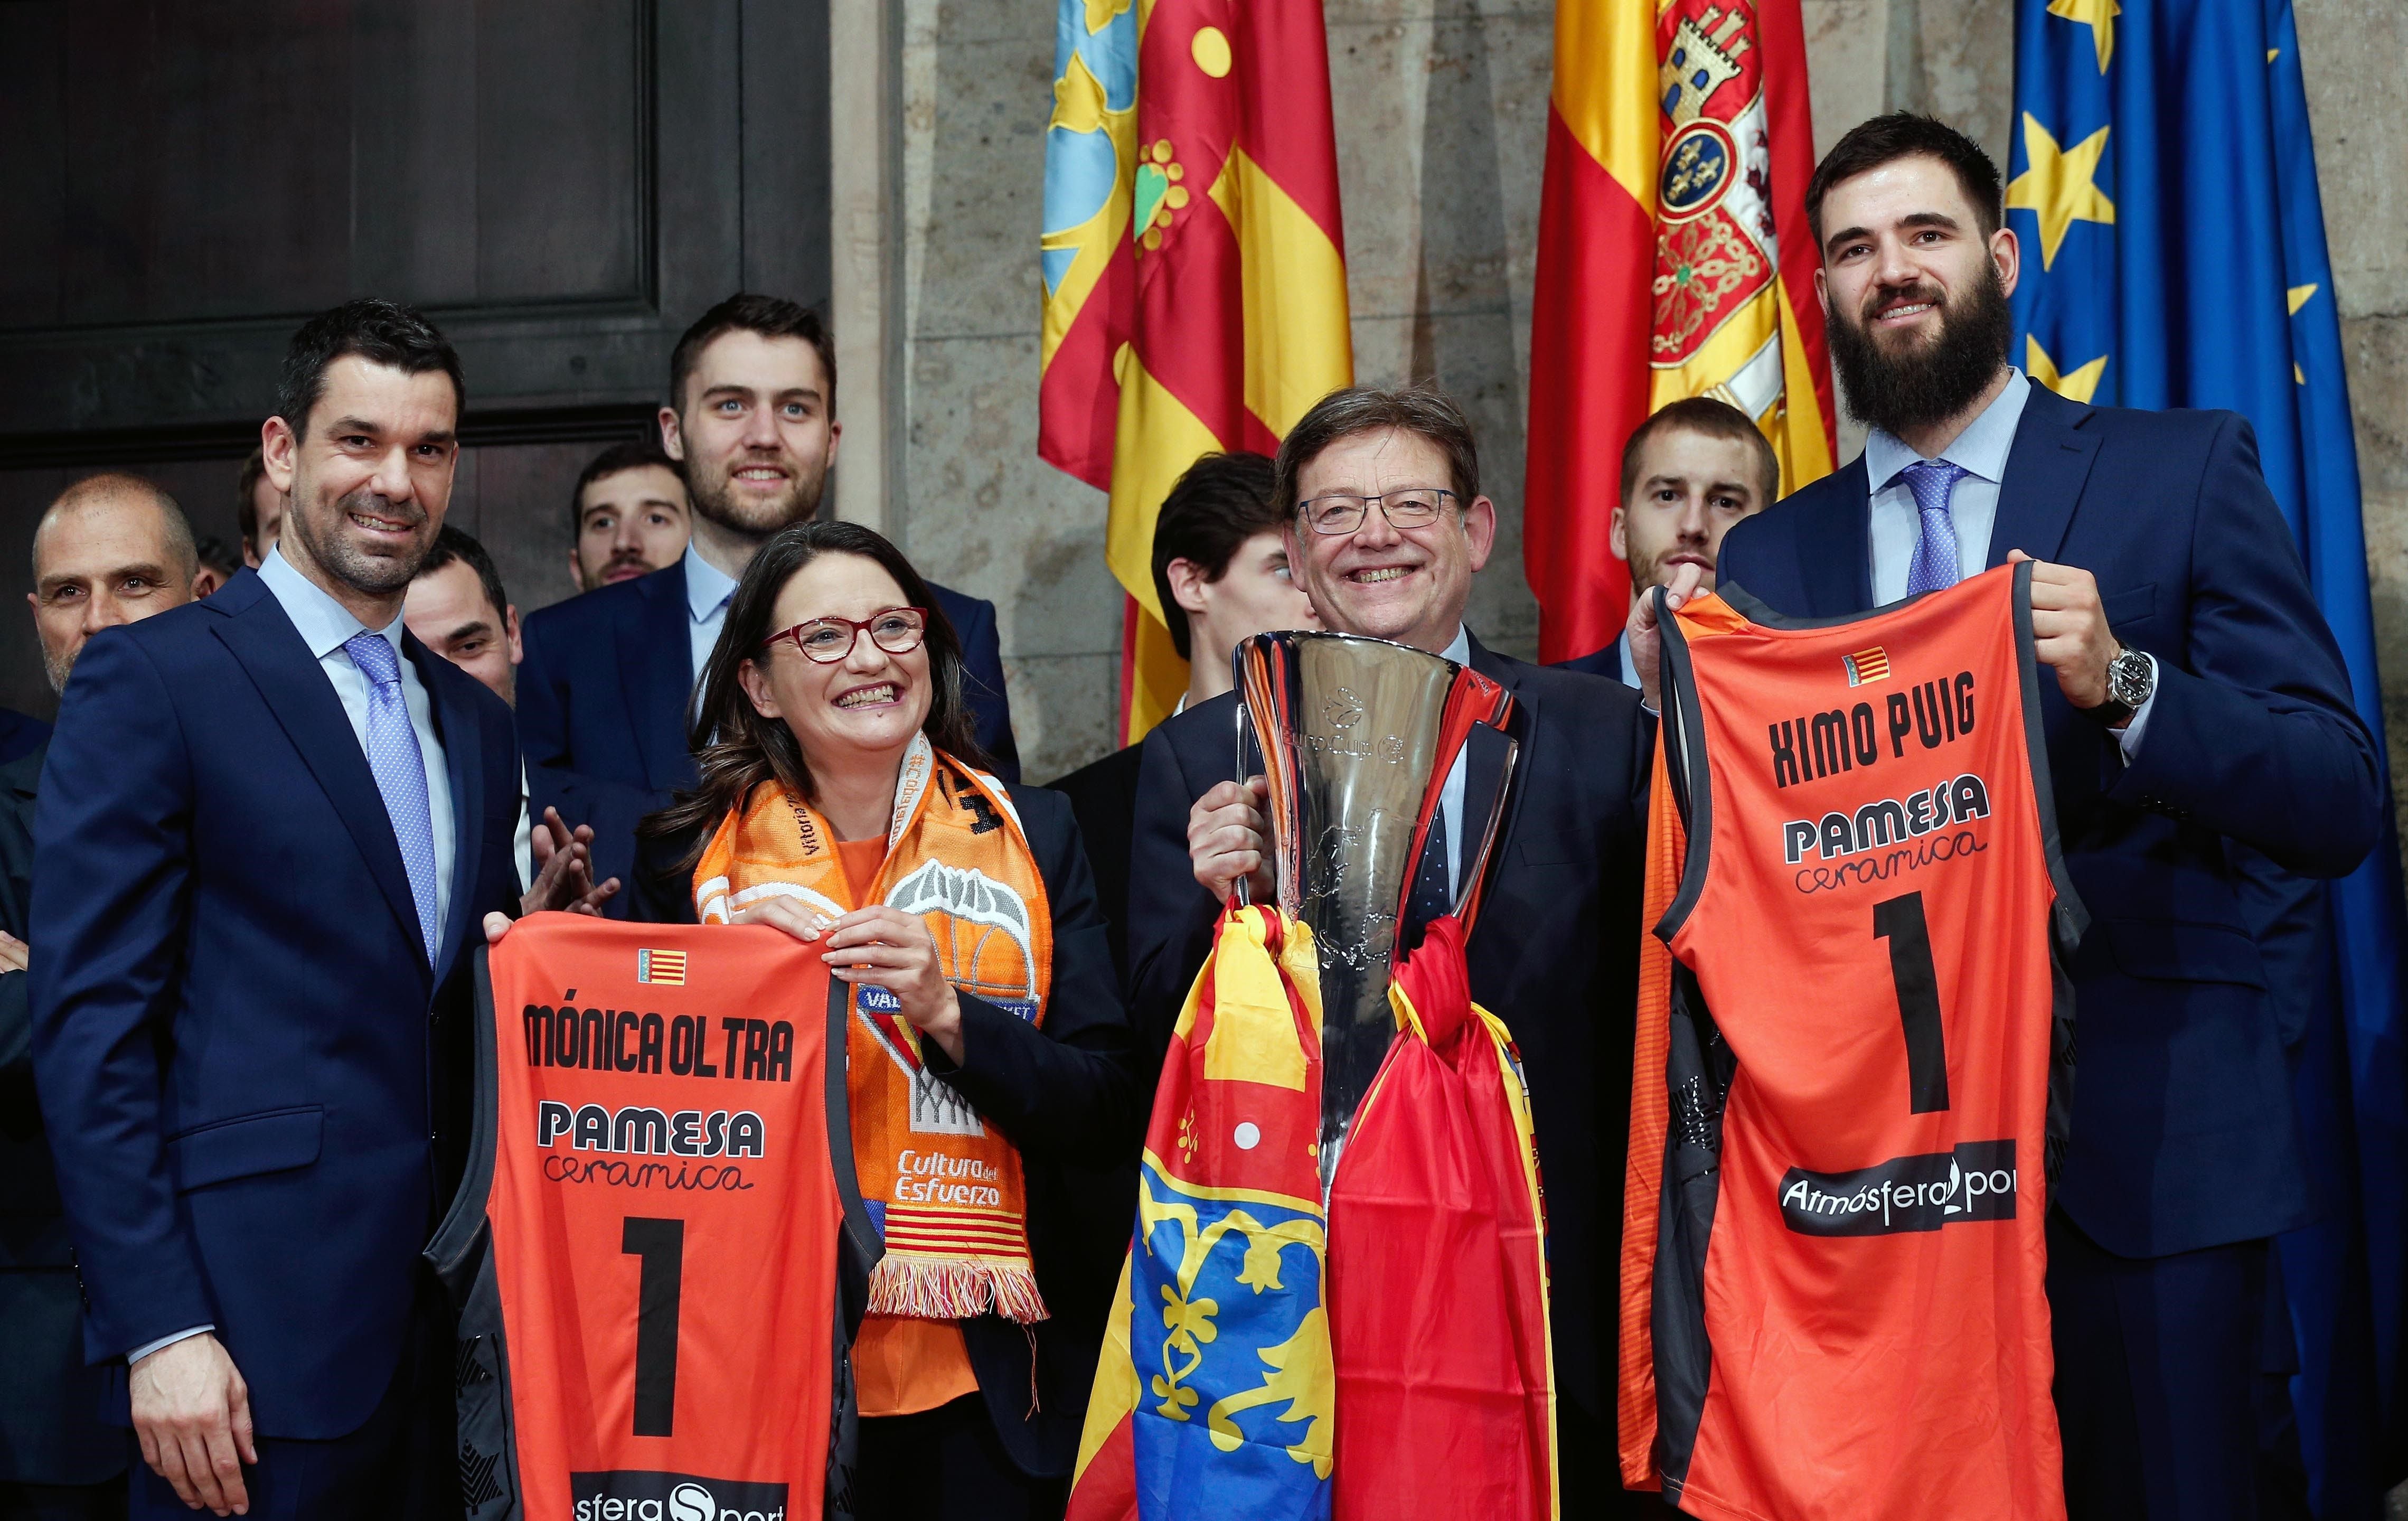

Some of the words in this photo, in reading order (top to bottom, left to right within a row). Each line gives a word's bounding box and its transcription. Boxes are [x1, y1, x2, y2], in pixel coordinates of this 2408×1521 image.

[1768, 701, 1878, 789] XIMO
[1886, 670, 1975, 758] PUIG
[1782, 773, 1991, 865] PAMESA
[1795, 830, 1988, 894] ceramica
[522, 988, 663, 1075] MÓNICA
[1873, 890, 1950, 1115] 1
[537, 1099, 766, 1159] PAMESA
[543, 1156, 754, 1191] ceramica
[895, 1176, 1000, 1206] Esfuerzo
[898, 1150, 983, 1179] Cultura
[1782, 1179, 1948, 1227] Atmósfera
[620, 1216, 685, 1438] 1
[572, 1492, 664, 1521] sfera
